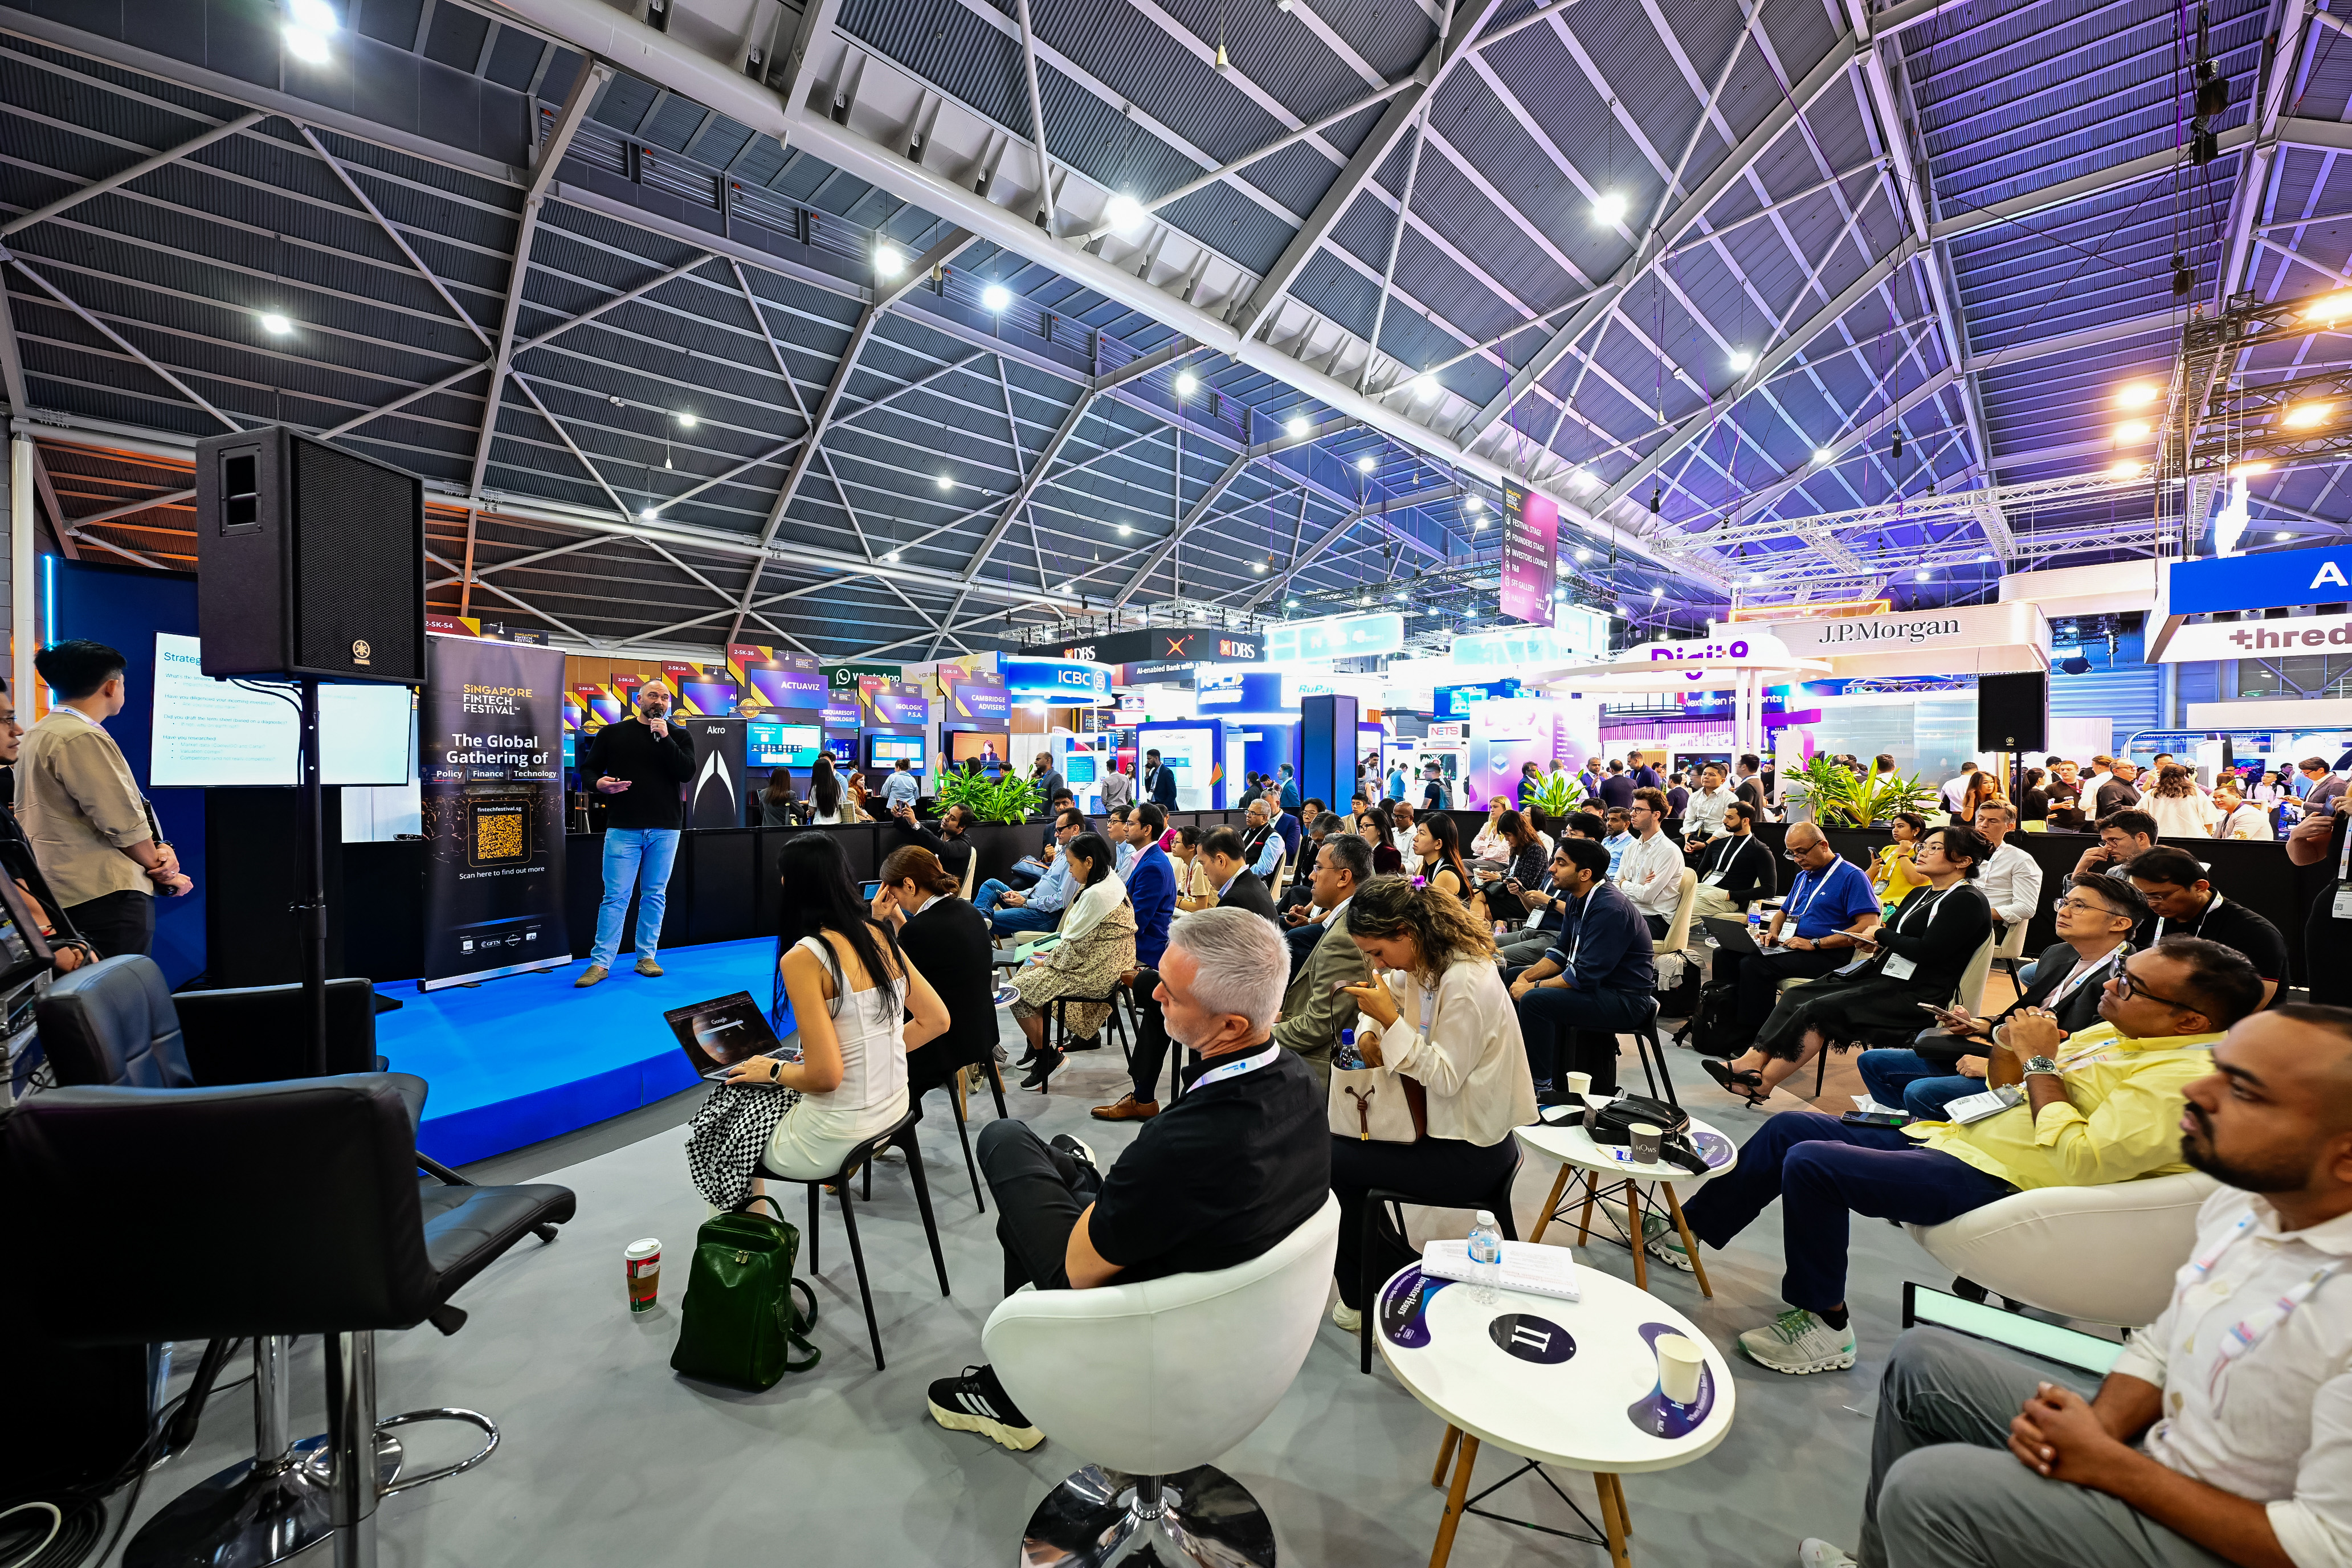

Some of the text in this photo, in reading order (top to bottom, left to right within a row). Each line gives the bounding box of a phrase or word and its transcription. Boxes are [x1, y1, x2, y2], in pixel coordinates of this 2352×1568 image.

[1513, 518, 1541, 537] FESTIVAL STAGE
[1512, 533, 1544, 552] FOUNDERS STAGE
[1512, 549, 1547, 569] INVESTORS LOUNGE
[1519, 581, 1534, 593] GALLERY
[1512, 594, 1521, 603] HALL
[1536, 602, 1544, 610] HALL
[1545, 594, 1553, 620] 2
[1074, 646, 1095, 660] DBS
[1231, 642, 1255, 658] DBS
[1137, 665, 1165, 674] AI-enabled
[852, 672, 900, 682] WApp
[1058, 670, 1090, 685] ICBC
[464, 684, 532, 697] SINGAPORE
[781, 681, 819, 691] ACTUAVIZ
[1298, 685, 1336, 694] RuPay
[464, 693, 512, 705] FINTECH
[1431, 726, 1459, 735] NETS
[452, 733, 538, 748] The Global
[447, 751, 549, 767] Gathering of
[1511, 1325, 1551, 1353] 11
